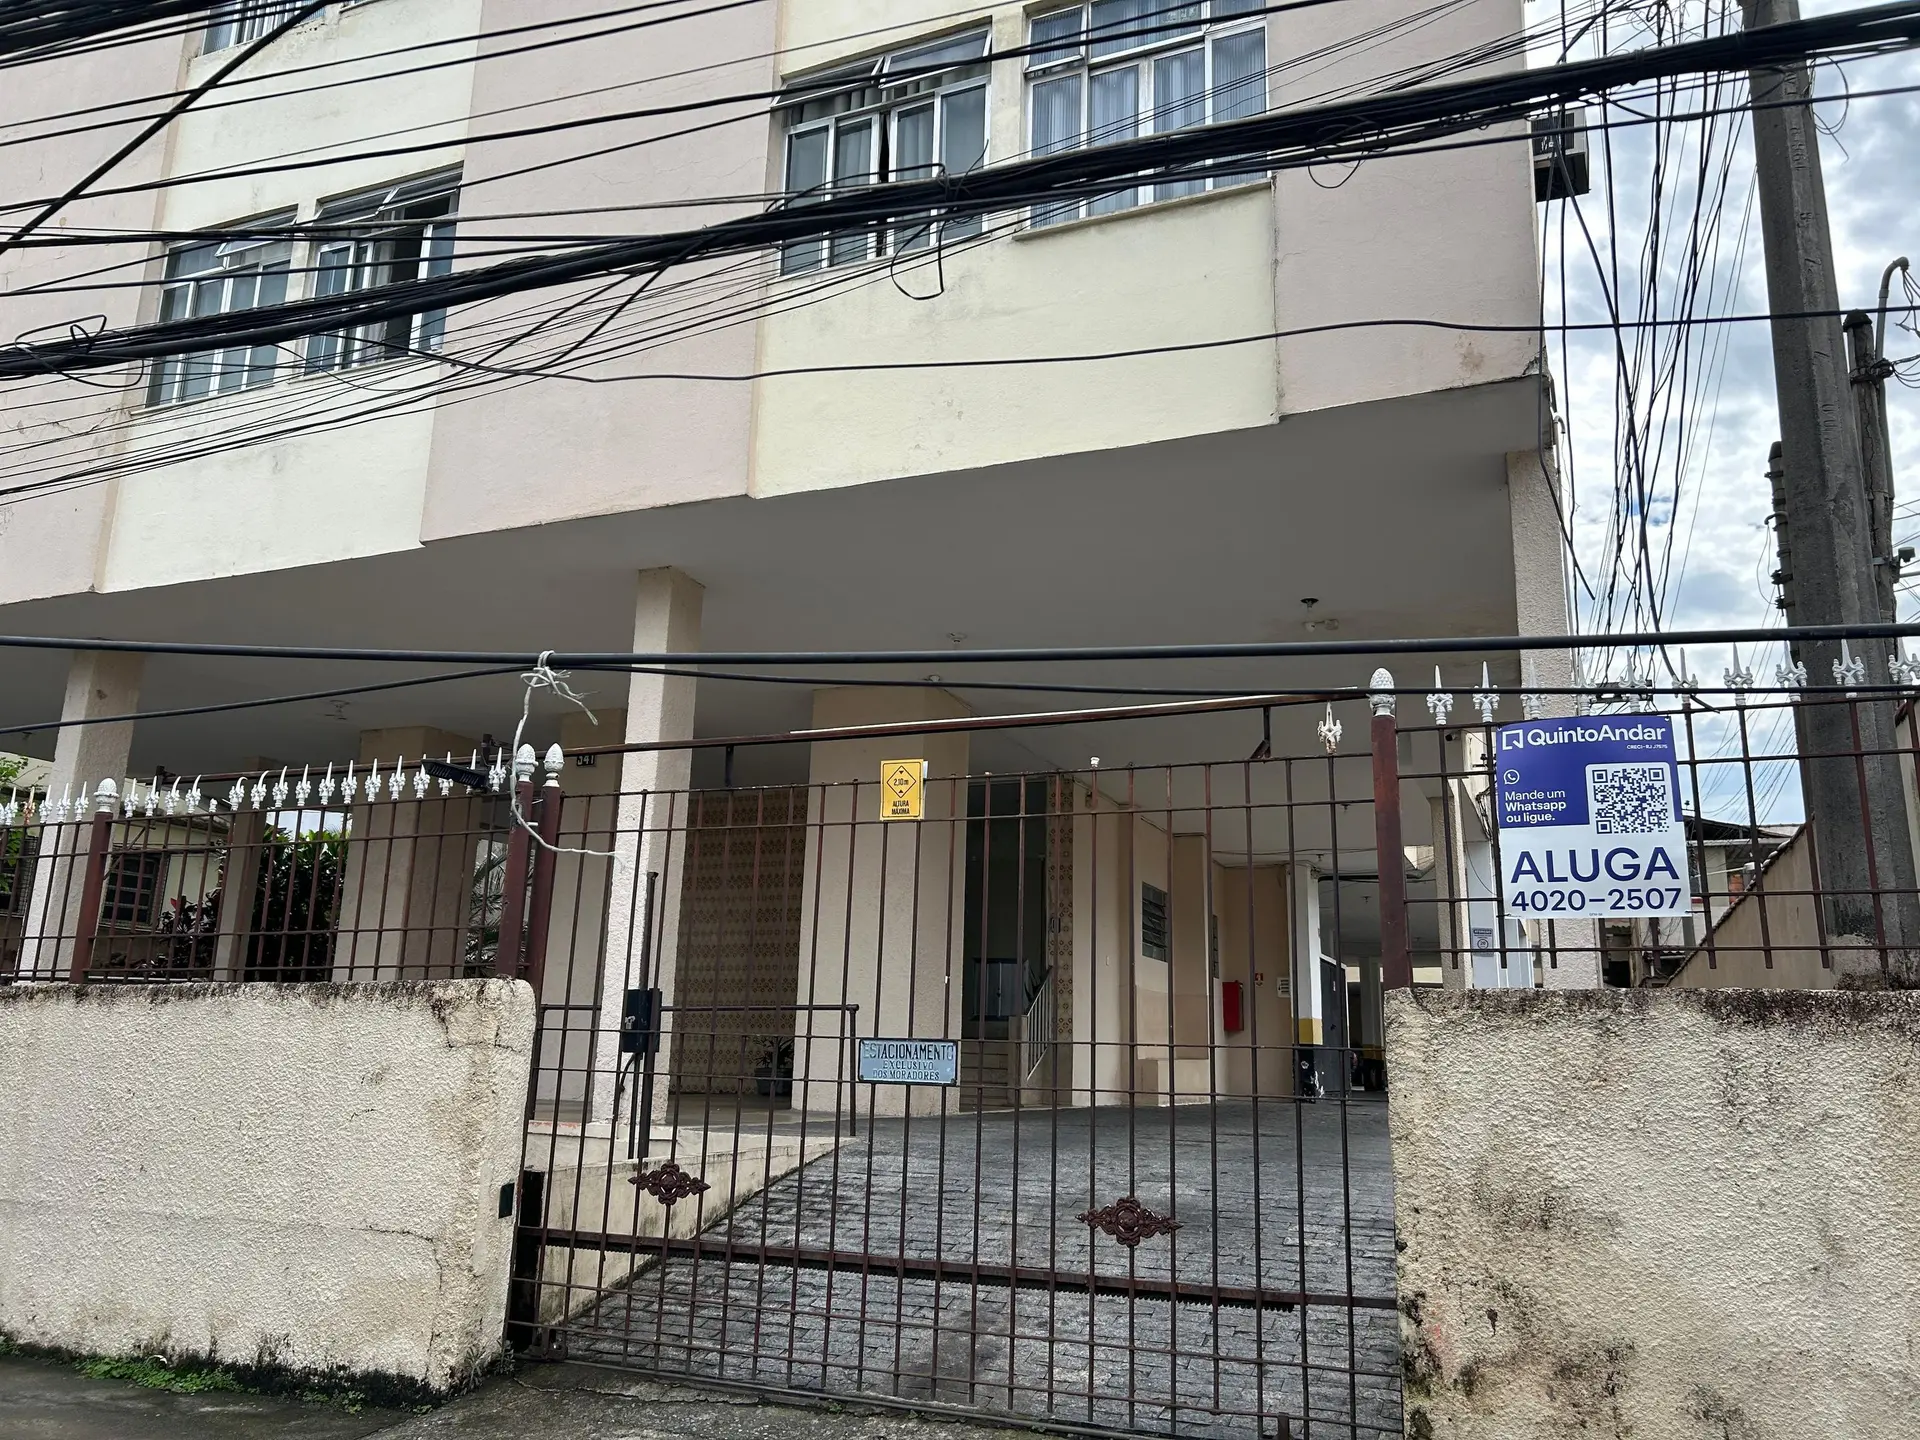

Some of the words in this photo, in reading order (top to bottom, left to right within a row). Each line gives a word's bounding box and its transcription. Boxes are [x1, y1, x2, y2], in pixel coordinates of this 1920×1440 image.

[1527, 724, 1666, 746] QuintoAndar
[1505, 790, 1544, 800] Mande
[1547, 790, 1566, 799] um
[1505, 801, 1567, 812] Whatsapp
[1506, 814, 1521, 823] ou
[1523, 812, 1556, 823] ligue.
[1510, 847, 1680, 883] ALUGA
[1511, 887, 1682, 912] 4020-2507
[863, 1043, 954, 1061] ESTACIONAMENTO
[883, 1060, 934, 1070] EXCLUSIVO
[873, 1069, 888, 1079] DOS
[890, 1070, 939, 1080] MORADORES
